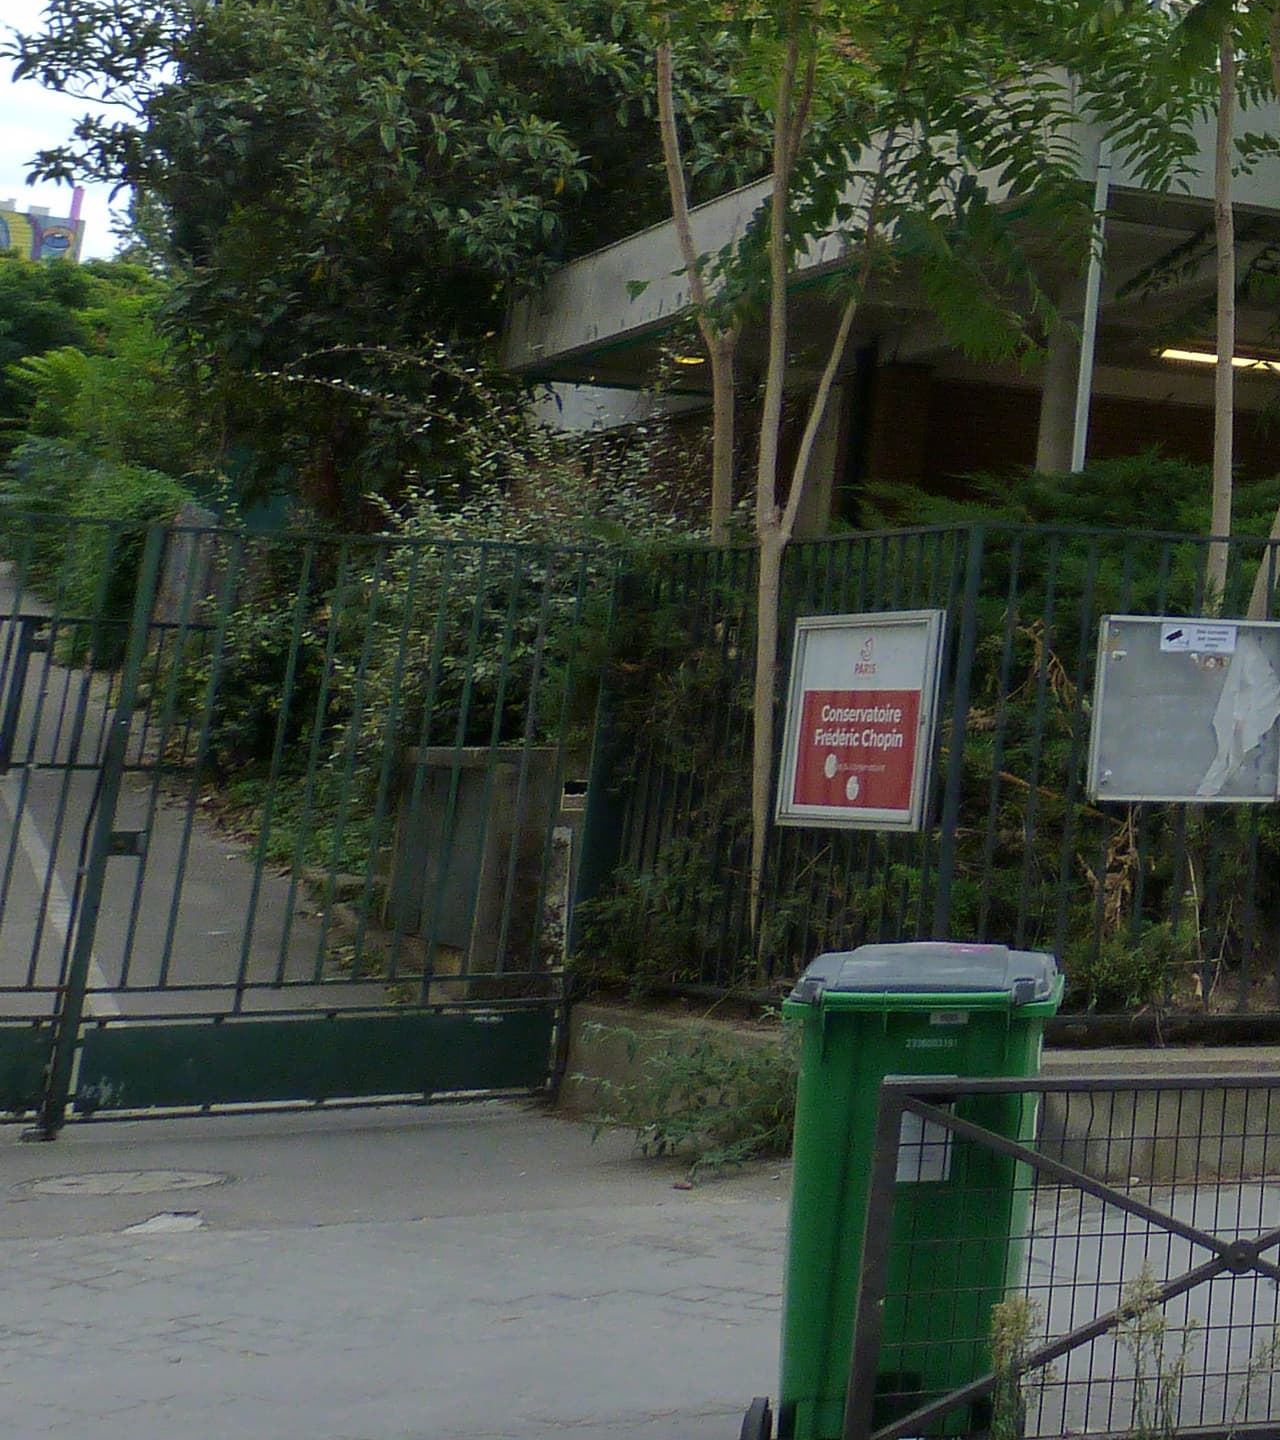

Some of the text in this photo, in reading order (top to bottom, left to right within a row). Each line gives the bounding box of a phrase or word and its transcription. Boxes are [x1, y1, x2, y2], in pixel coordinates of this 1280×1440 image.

[855, 663, 876, 673] PARIS
[823, 704, 902, 722] Conservatoire
[814, 728, 904, 751] Frédéric Chopin
